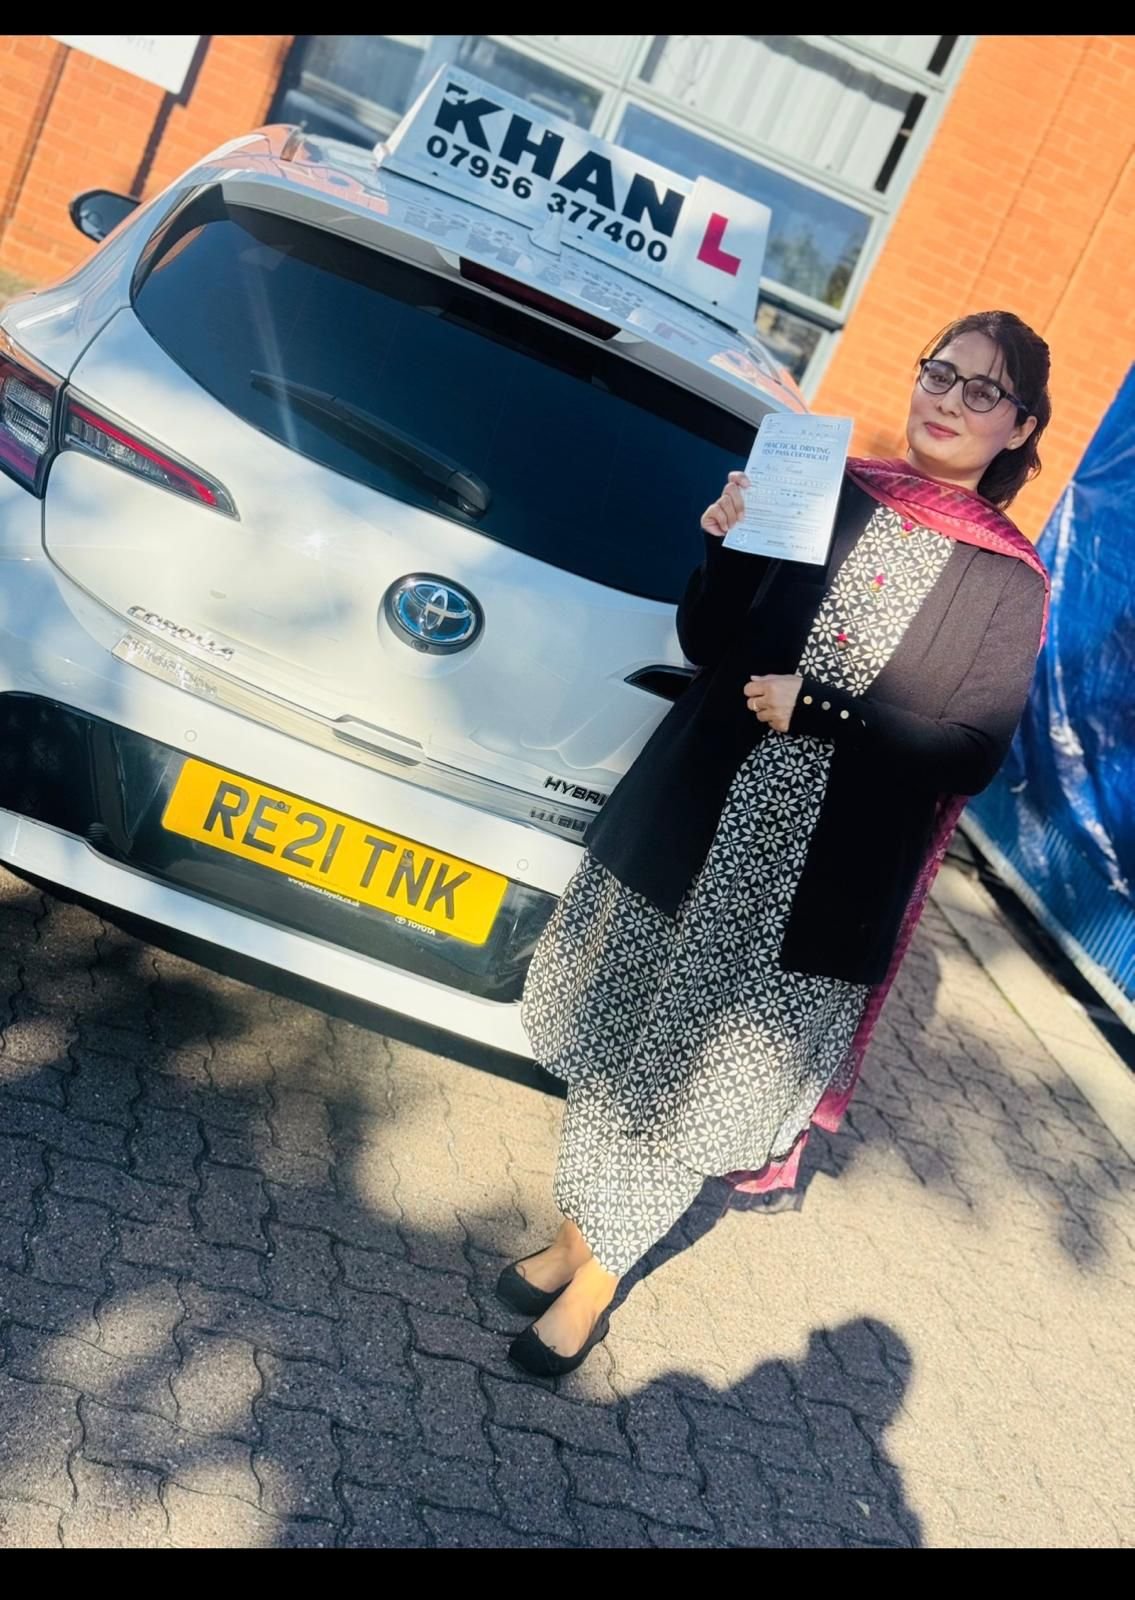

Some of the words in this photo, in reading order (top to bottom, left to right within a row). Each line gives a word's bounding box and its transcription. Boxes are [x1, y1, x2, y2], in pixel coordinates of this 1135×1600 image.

[434, 82, 686, 238] KHAN
[426, 135, 532, 200] 07956
[546, 192, 668, 262] 377400
[696, 212, 742, 277] L
[800, 444, 831, 455] DRIVING
[543, 775, 608, 807] HYBRI
[202, 780, 346, 874] RE21
[359, 834, 472, 921] TNK
[407, 919, 436, 937] TOYOTA
